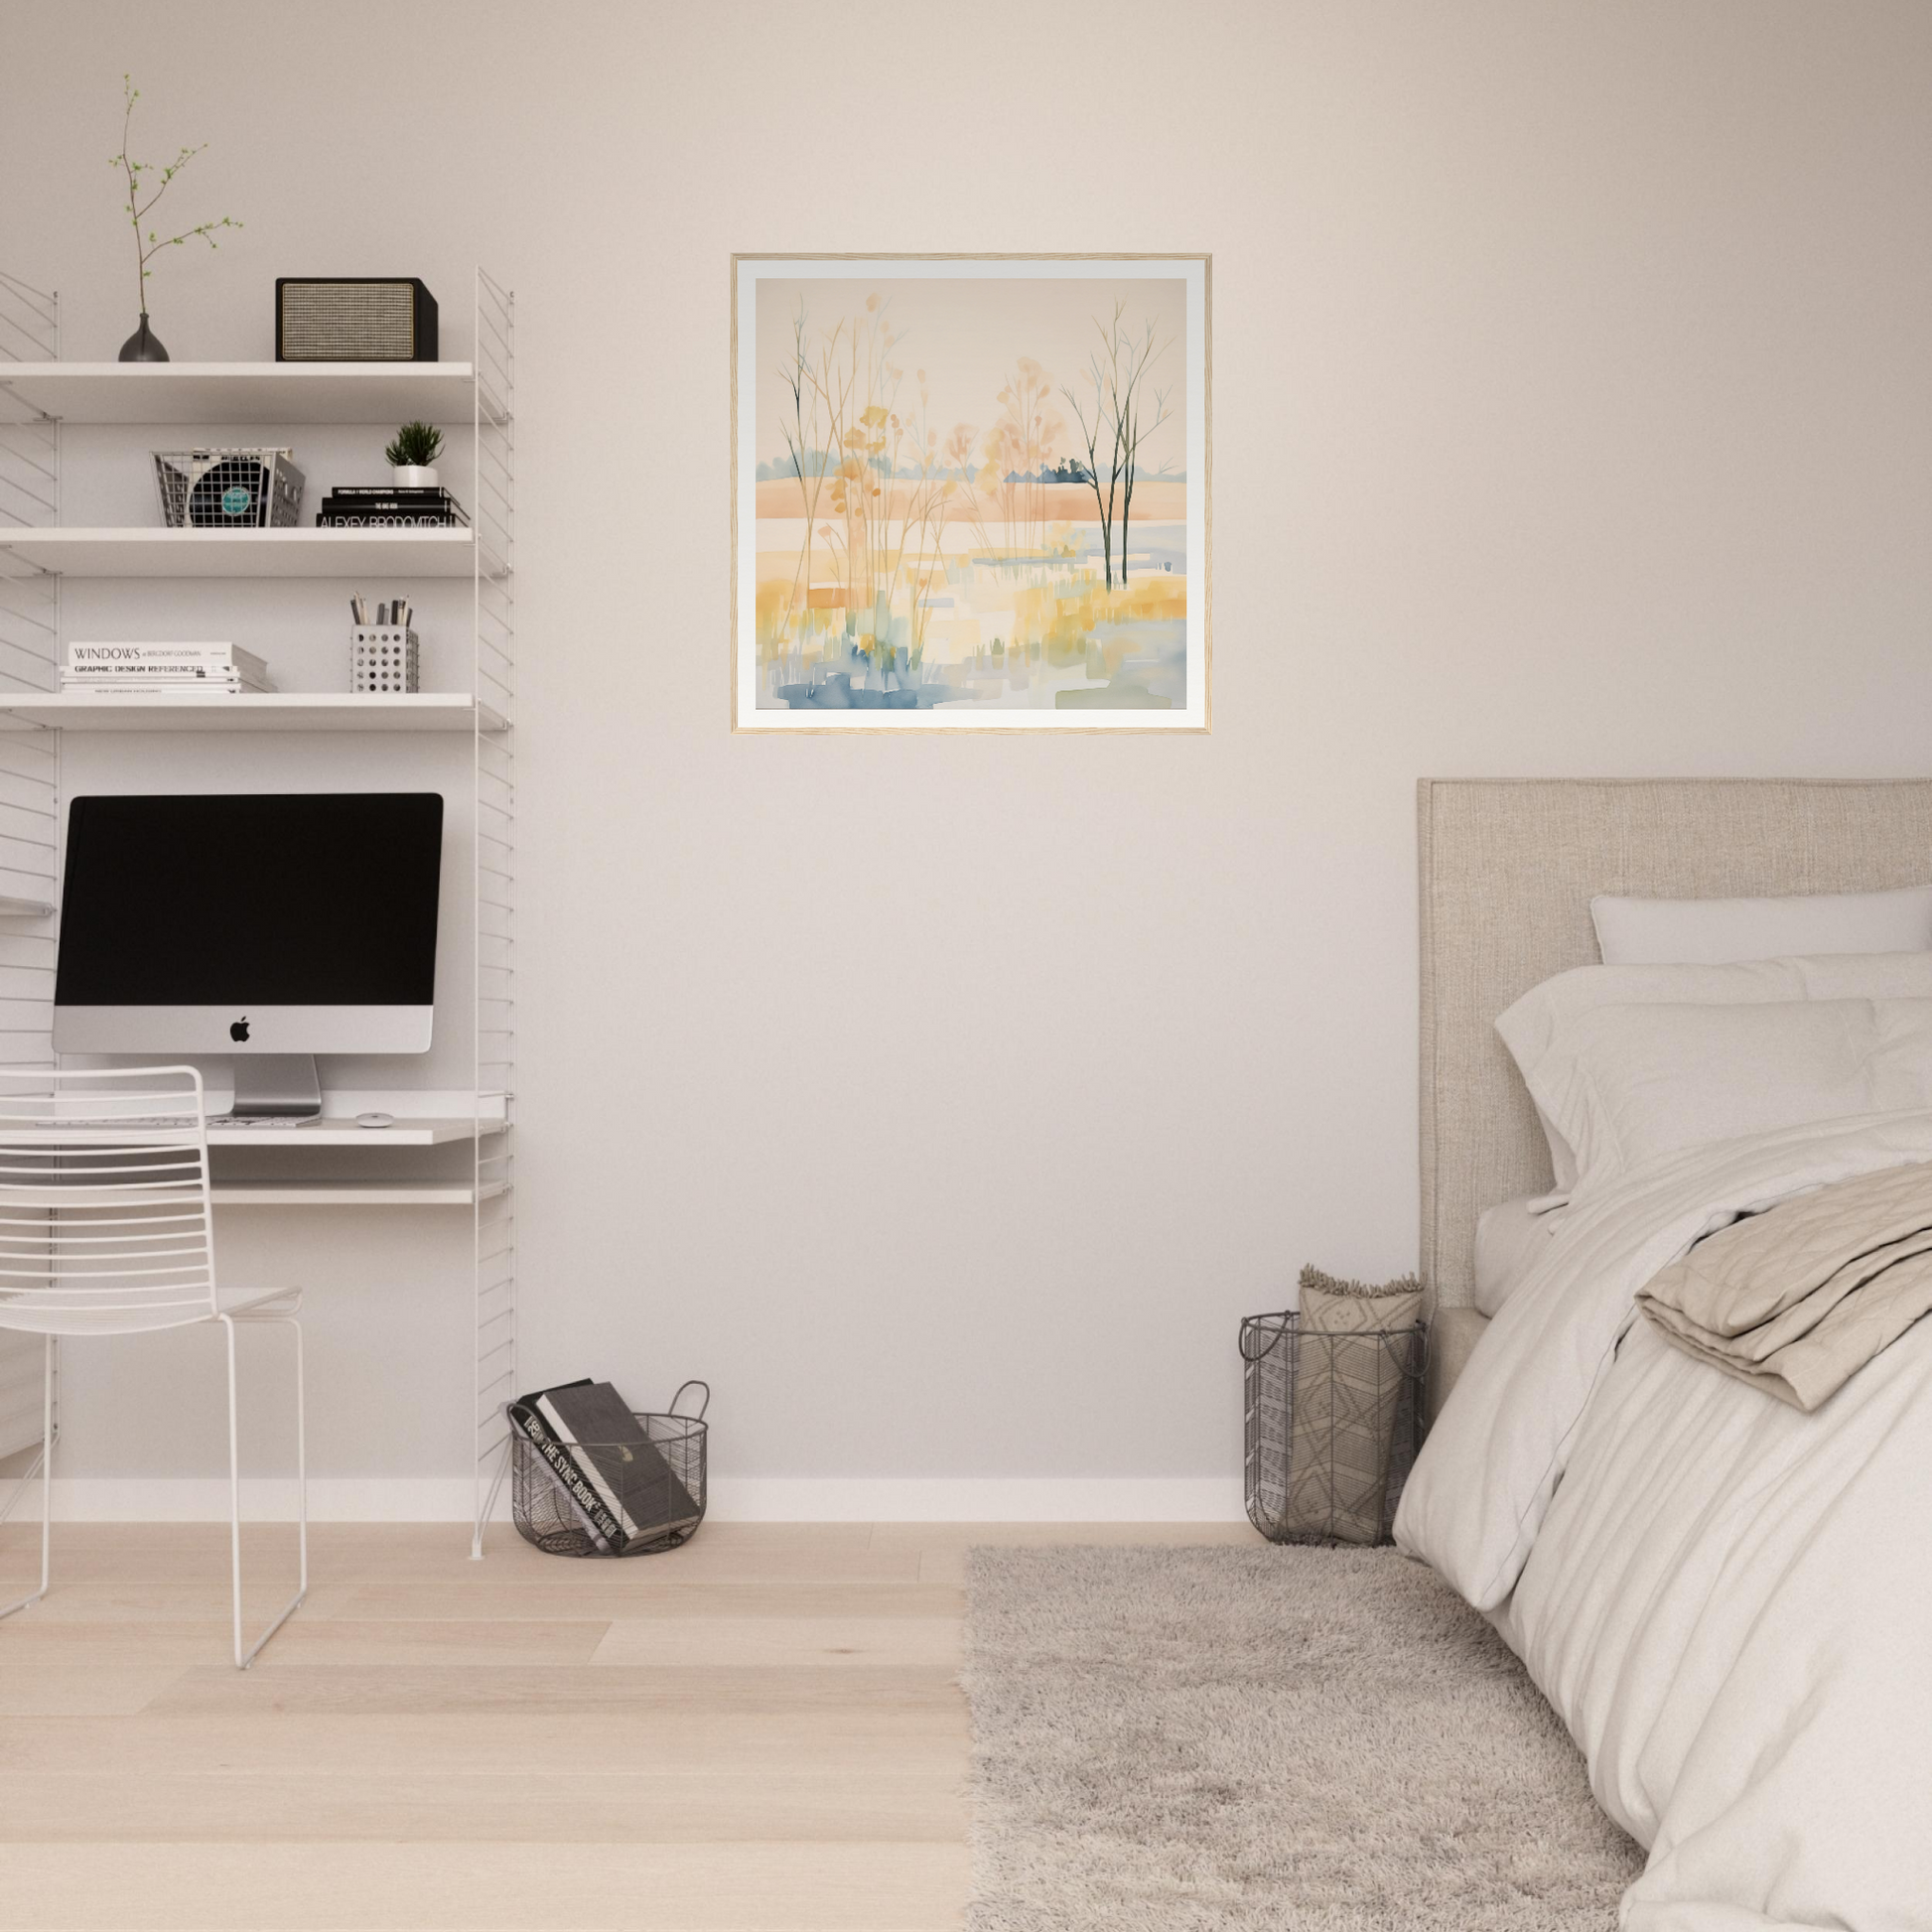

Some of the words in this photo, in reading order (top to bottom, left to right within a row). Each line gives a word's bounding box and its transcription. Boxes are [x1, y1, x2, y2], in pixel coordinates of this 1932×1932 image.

[321, 516, 366, 528] ALEXEY
[369, 516, 446, 528] BRODOVITCH
[74, 648, 140, 660] WINDOWS
[541, 1437, 560, 1462] THE
[554, 1455, 578, 1487] SYNC
